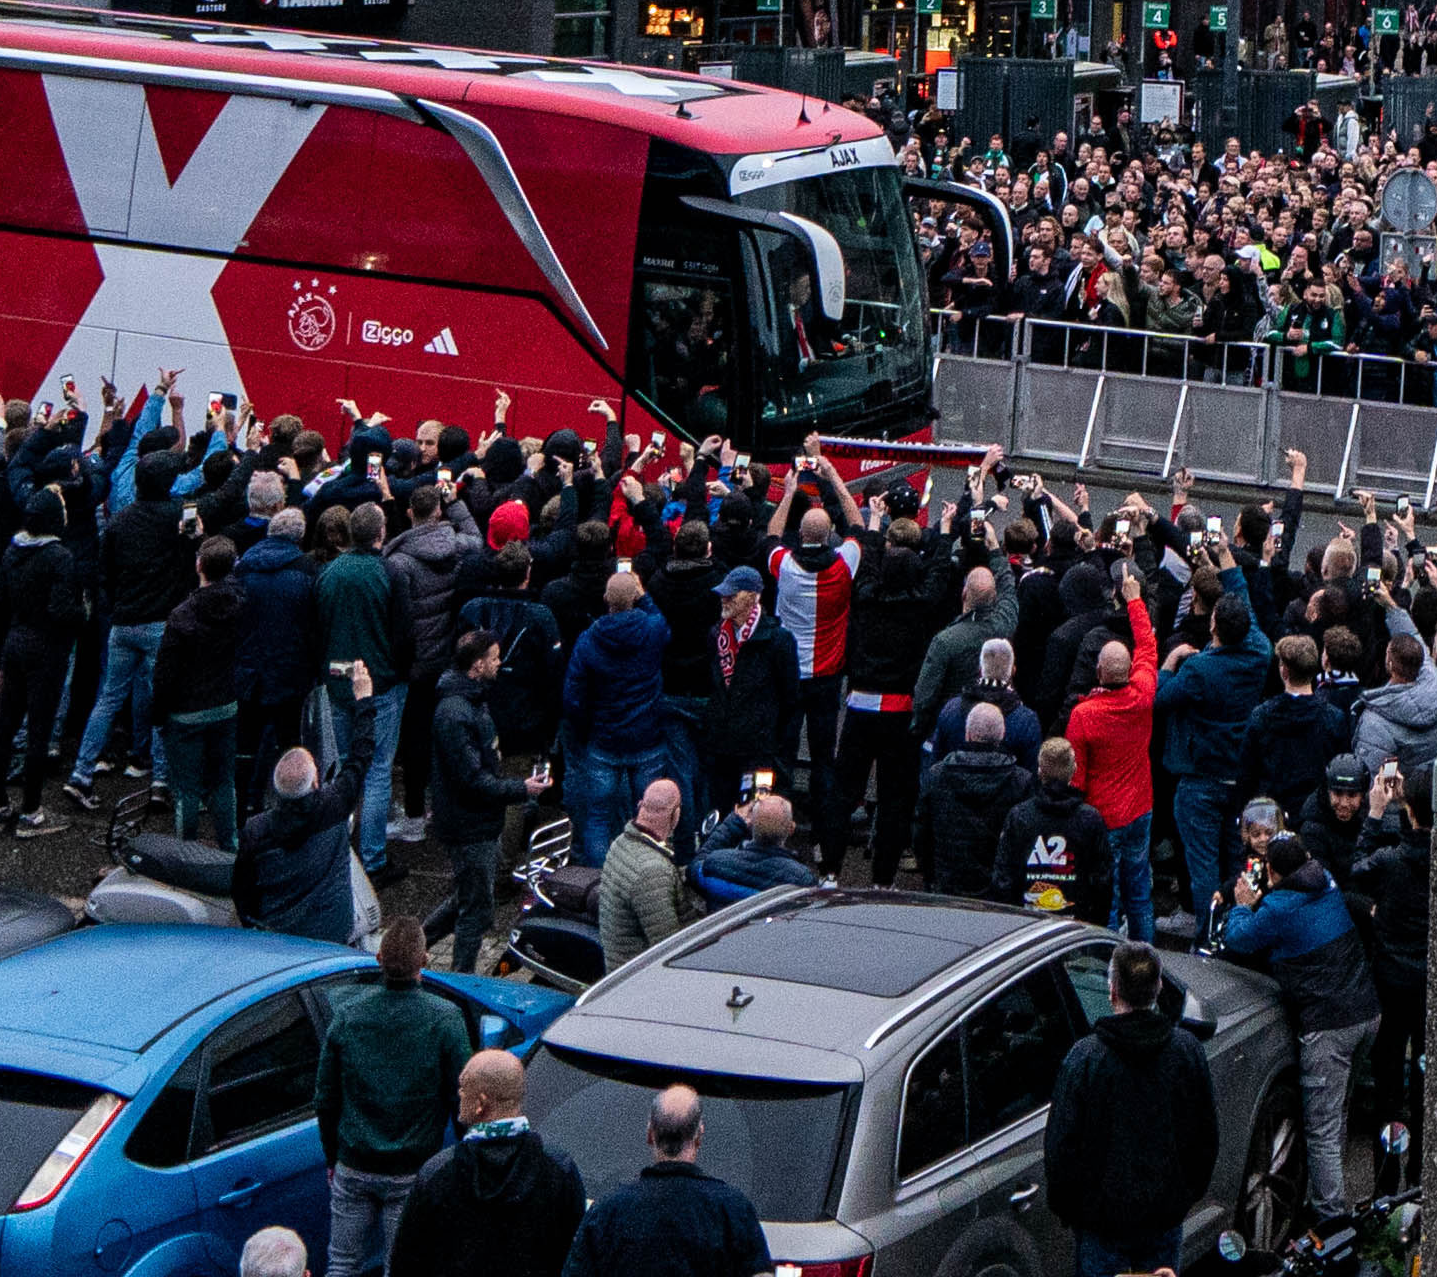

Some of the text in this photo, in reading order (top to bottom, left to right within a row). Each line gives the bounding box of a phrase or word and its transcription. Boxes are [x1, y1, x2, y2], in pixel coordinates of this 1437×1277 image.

[1038, 0, 1046, 13] 3
[1153, 10, 1163, 23] 4
[1217, 12, 1227, 26] 5
[1382, 15, 1392, 29] 6
[830, 147, 861, 168] AJAX
[287, 292, 312, 318] AJAX
[362, 320, 414, 346] Ziggo
[1026, 834, 1067, 865] A2
